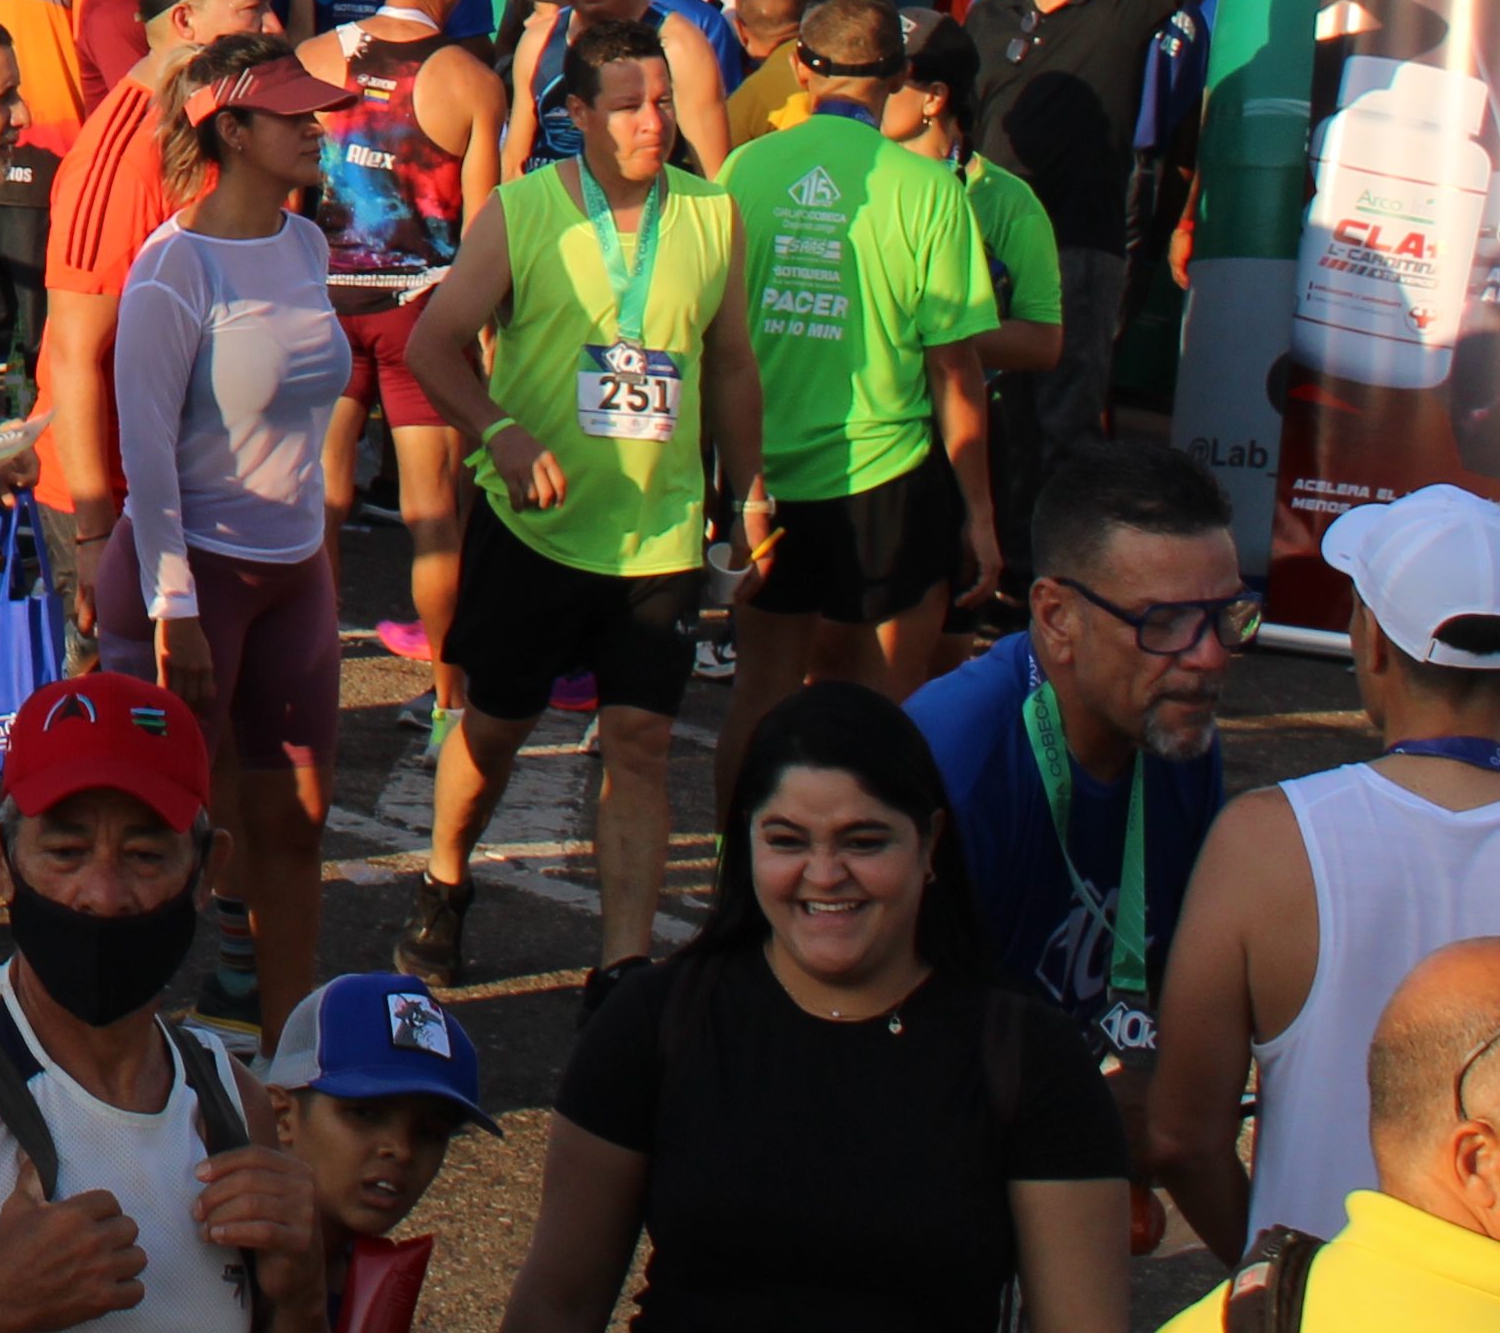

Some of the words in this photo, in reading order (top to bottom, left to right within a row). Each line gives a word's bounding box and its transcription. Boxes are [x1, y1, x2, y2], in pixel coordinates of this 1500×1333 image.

[345, 143, 397, 171] Alex
[761, 287, 849, 318] PACER
[807, 322, 843, 341] MIN
[598, 375, 671, 413] 251
[1292, 479, 1371, 499] ACELERA
[1375, 488, 1397, 502] EL
[1033, 692, 1059, 779] COBECA
[1102, 1009, 1157, 1049] 10k
